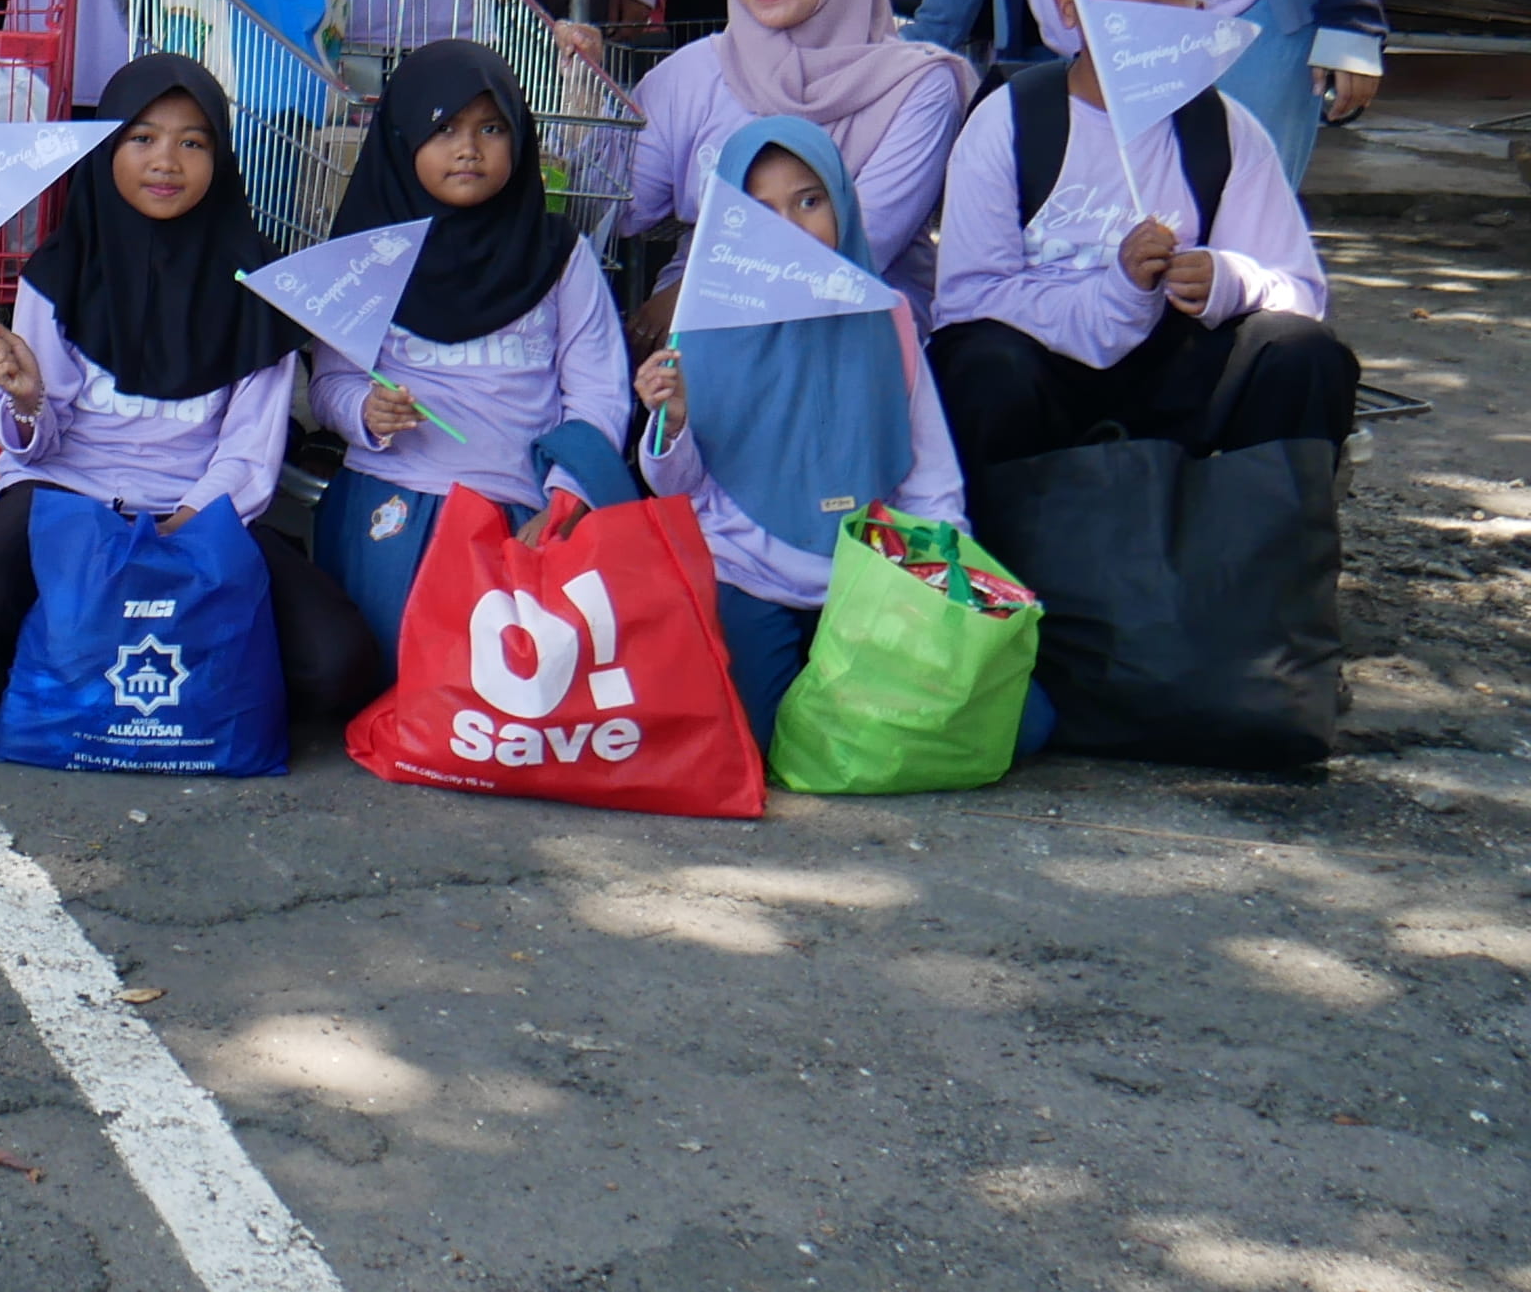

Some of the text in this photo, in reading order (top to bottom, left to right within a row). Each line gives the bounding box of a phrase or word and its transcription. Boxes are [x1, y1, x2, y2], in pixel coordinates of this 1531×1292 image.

[1112, 34, 1213, 71] Shopping Ceria
[1152, 81, 1185, 99] ASTRA
[707, 243, 823, 288] Shopping Ceria
[305, 251, 380, 317] Shopping Ceria
[358, 294, 384, 318] ASTRA
[730, 291, 767, 310] ASTRA
[122, 598, 177, 619] TACI
[107, 724, 184, 738] ALKAUTSAR
[449, 708, 641, 768] Save
[73, 752, 111, 767] BULAN
[111, 758, 178, 772] RAMADHAN
[178, 760, 217, 771] PENUH
